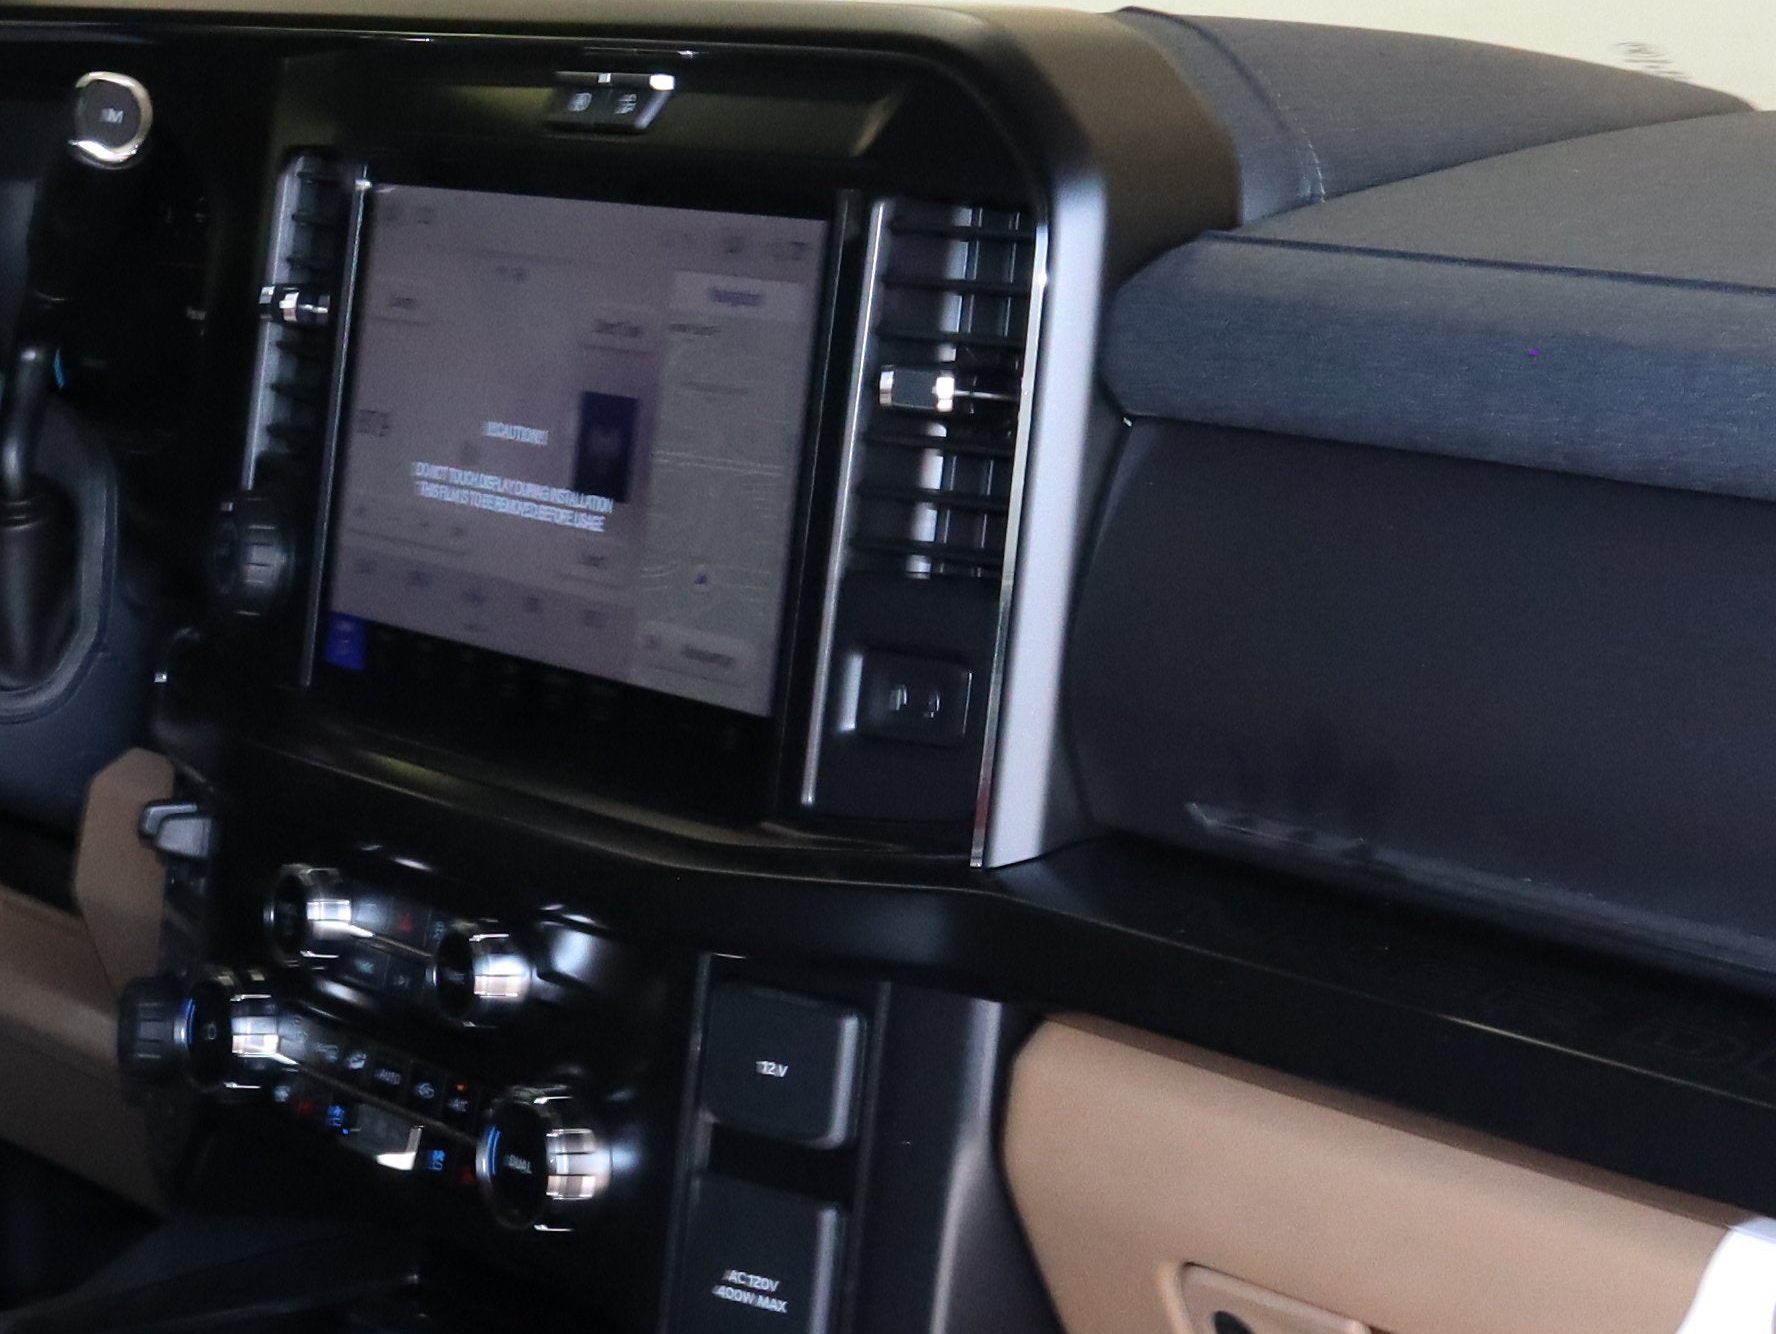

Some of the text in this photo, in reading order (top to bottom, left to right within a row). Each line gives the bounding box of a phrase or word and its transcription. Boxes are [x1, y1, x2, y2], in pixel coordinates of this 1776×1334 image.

[449, 467, 478, 487] TOUCH
[480, 473, 513, 494] DISPLAY
[550, 486, 613, 513] INSTALLATION
[713, 1285, 787, 1313] 400W MAX
